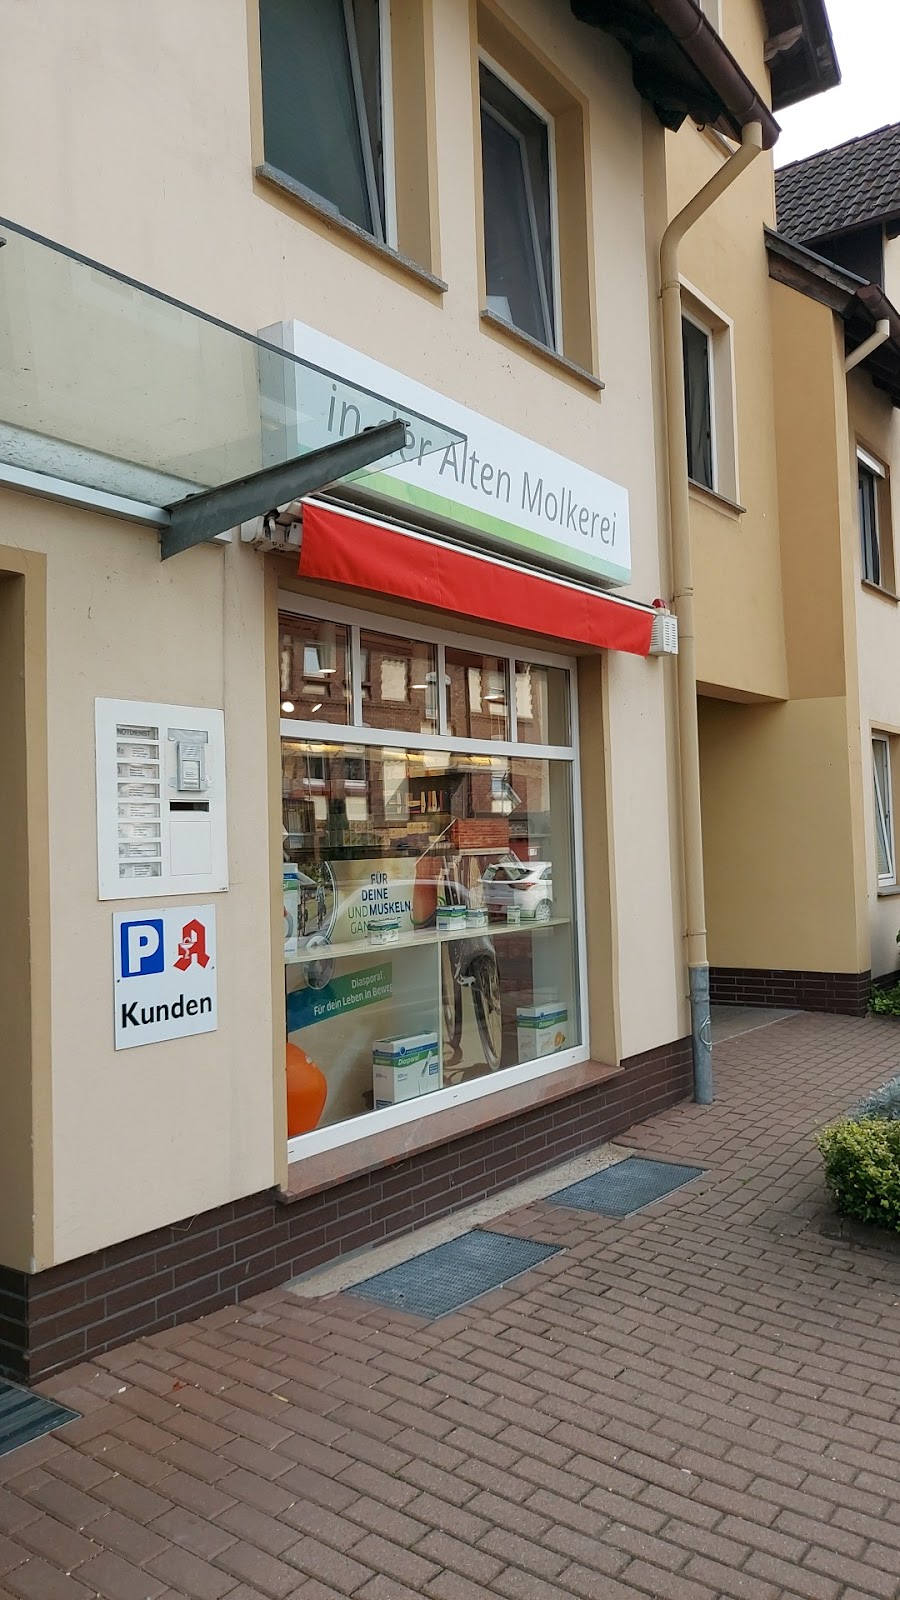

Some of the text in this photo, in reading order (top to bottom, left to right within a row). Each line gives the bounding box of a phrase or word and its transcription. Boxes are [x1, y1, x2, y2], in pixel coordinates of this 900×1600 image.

[327, 384, 361, 437] in
[438, 440, 512, 504] Alten
[521, 471, 618, 547] Molkerei
[370, 871, 388, 885] FÜR
[361, 888, 389, 901] DEINE
[347, 900, 413, 918] UND MUSKELN.
[350, 921, 369, 934] GAN
[127, 924, 160, 974] P
[121, 994, 212, 1028] Kunden
[313, 1003, 326, 1016] Für
[327, 997, 342, 1011] dein
[342, 991, 364, 1006] Leben
[364, 989, 372, 999] in
